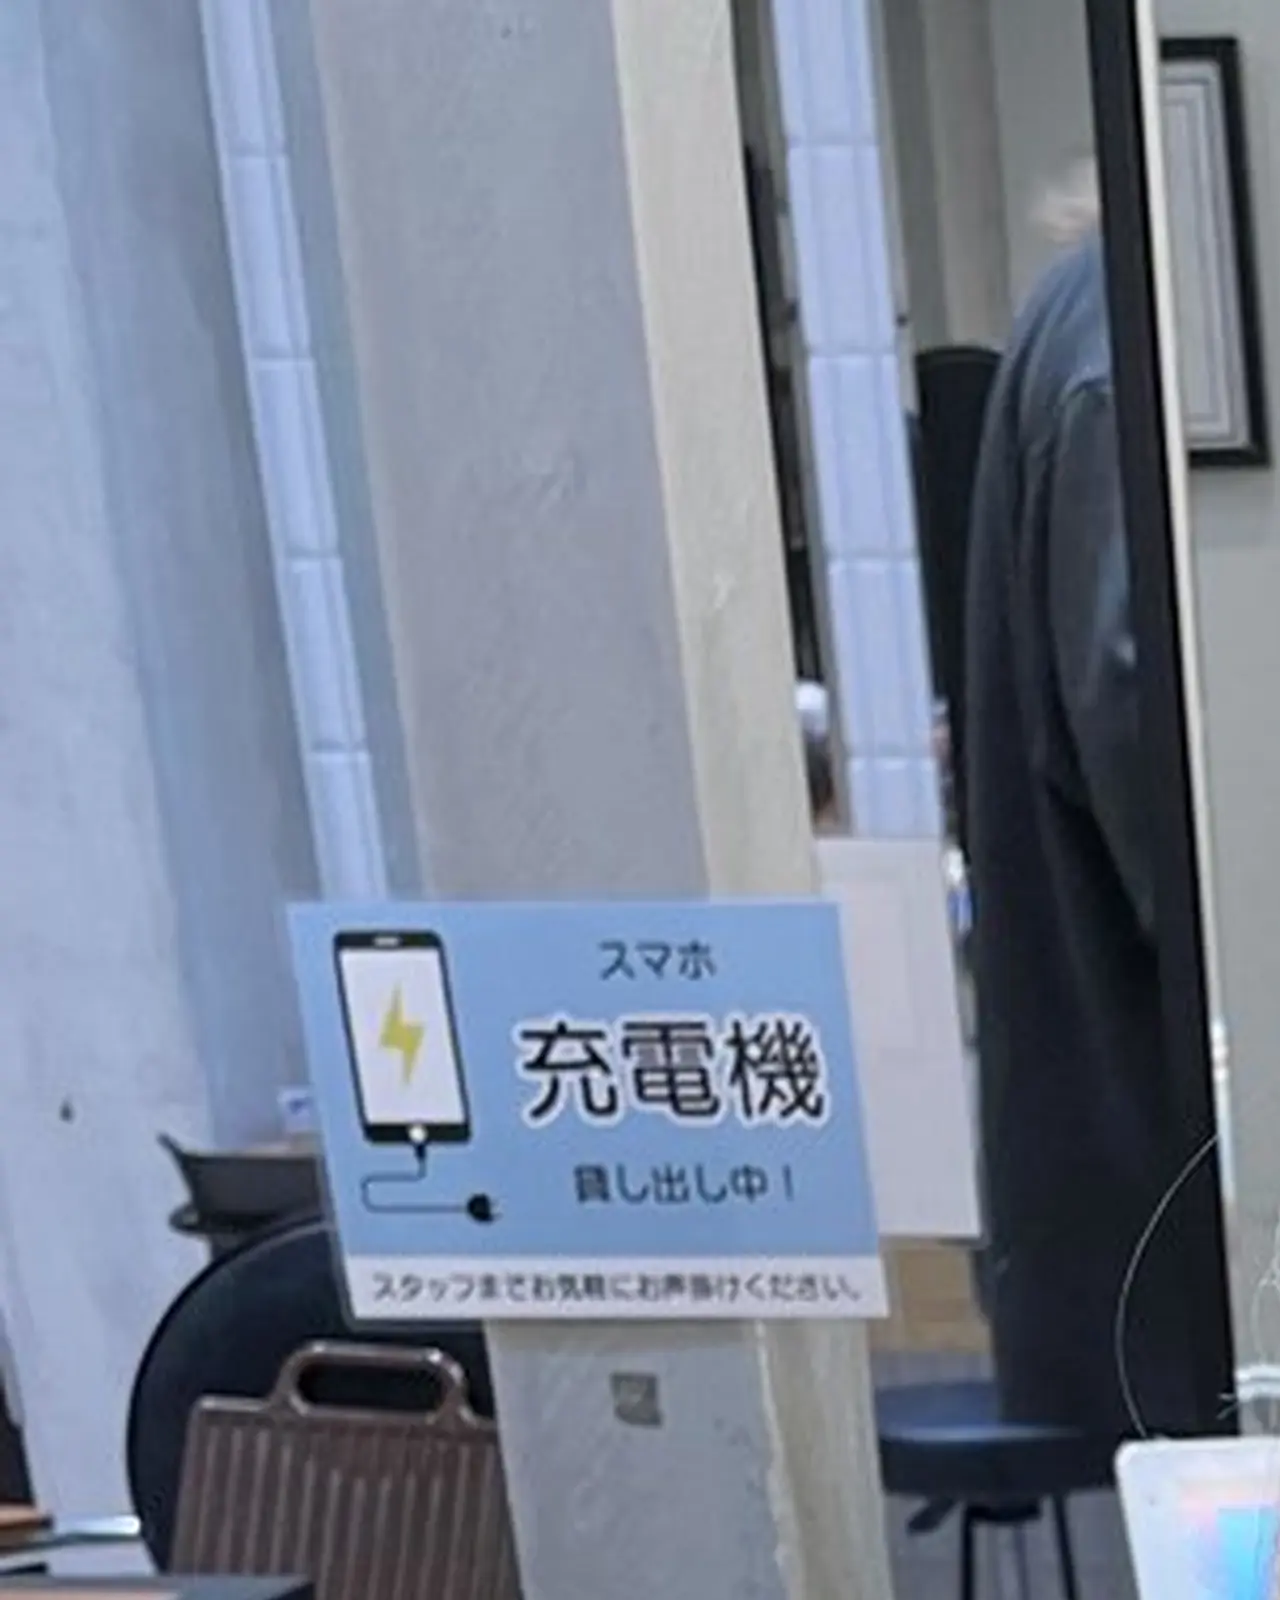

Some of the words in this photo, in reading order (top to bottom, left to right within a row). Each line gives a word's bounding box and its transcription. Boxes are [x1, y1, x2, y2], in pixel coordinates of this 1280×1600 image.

[599, 938, 719, 982] スマホ
[518, 1018, 826, 1120] 充電機
[573, 1163, 796, 1205] 貸し出し中！
